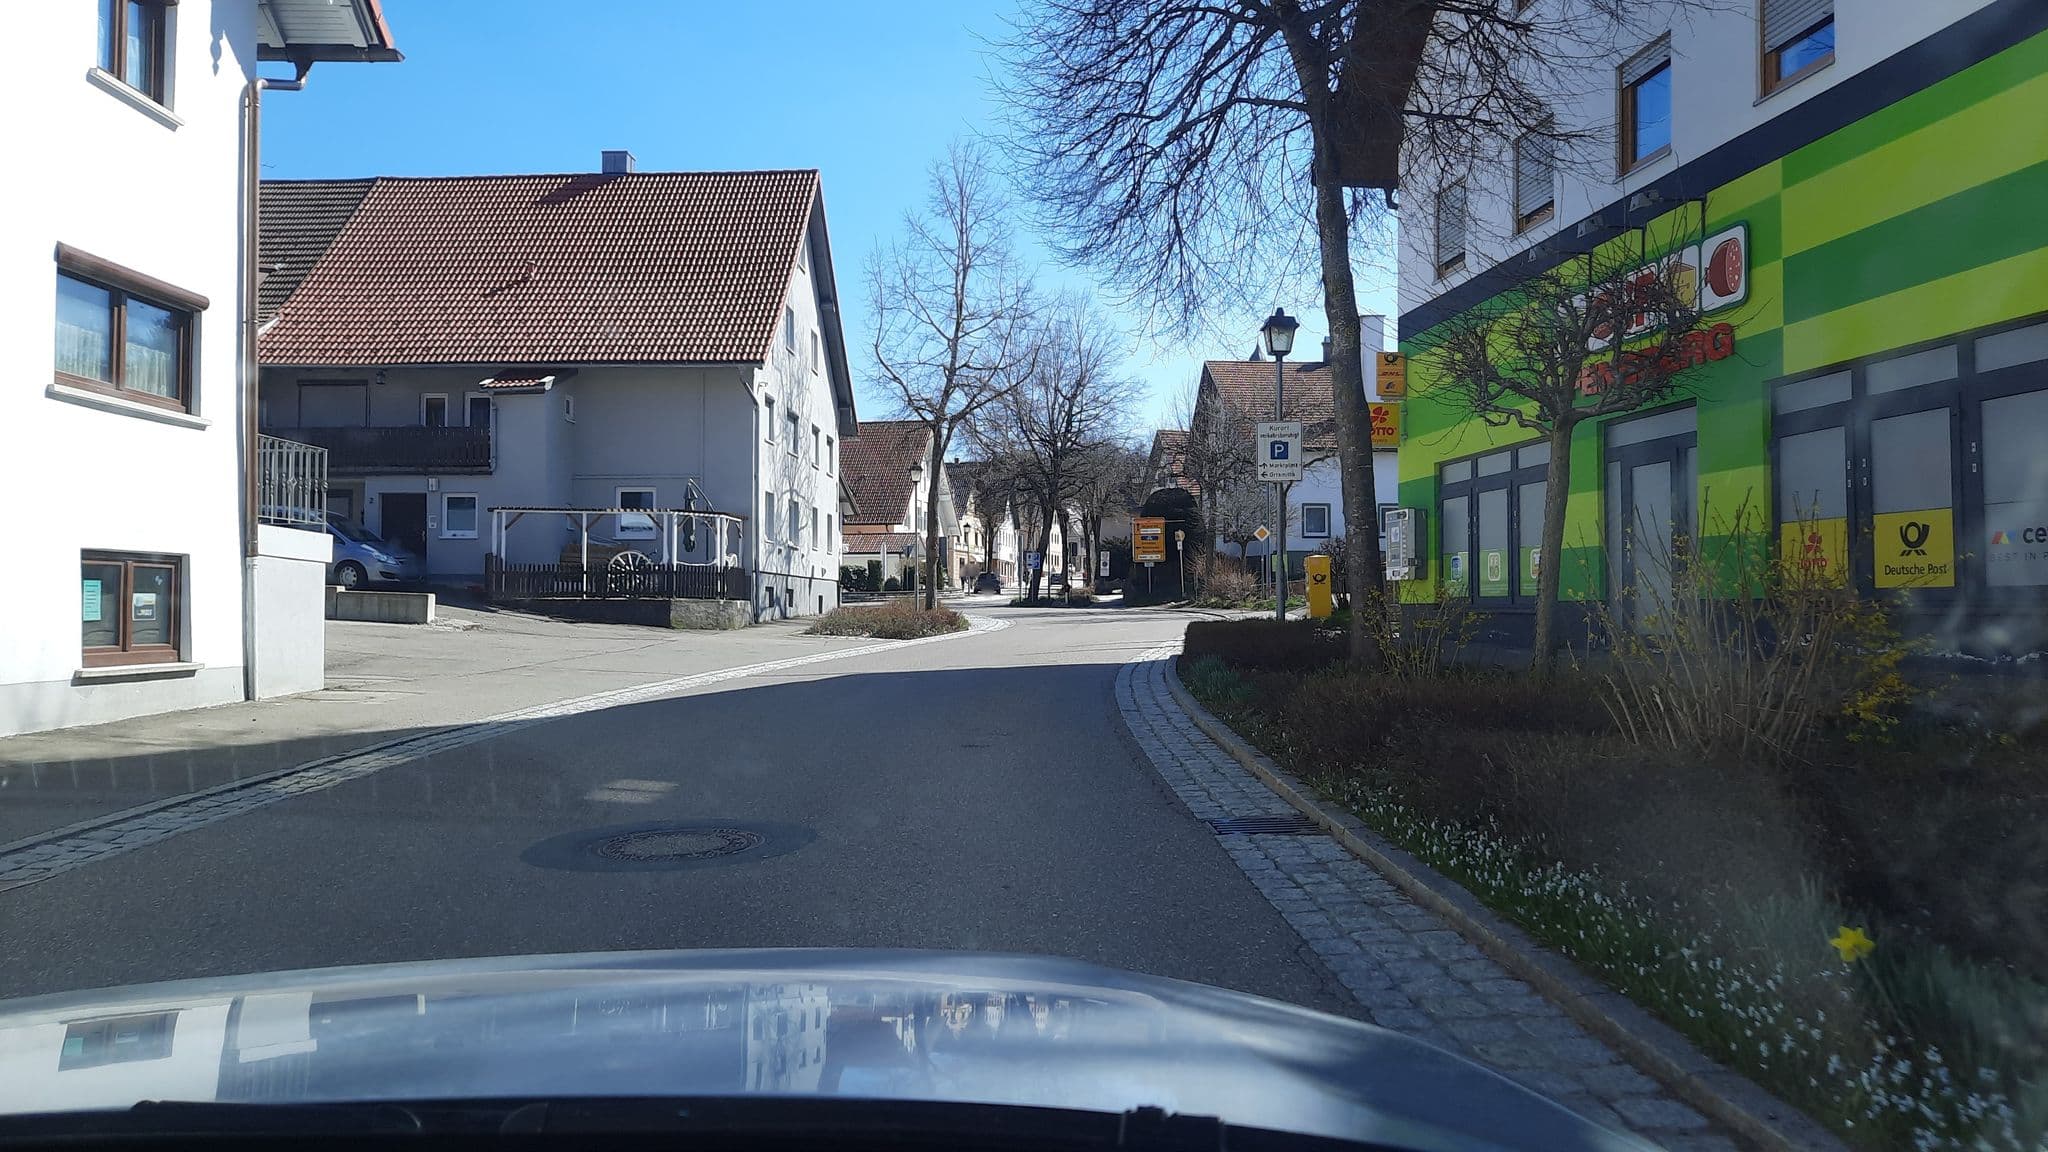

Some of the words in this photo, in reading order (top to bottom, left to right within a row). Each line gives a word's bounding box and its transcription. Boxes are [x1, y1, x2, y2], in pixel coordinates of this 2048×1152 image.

[1371, 427, 1396, 436] OTTO
[1274, 444, 1285, 457] P
[1884, 563, 1926, 576] Deutsche
[1927, 563, 1948, 575] Post
